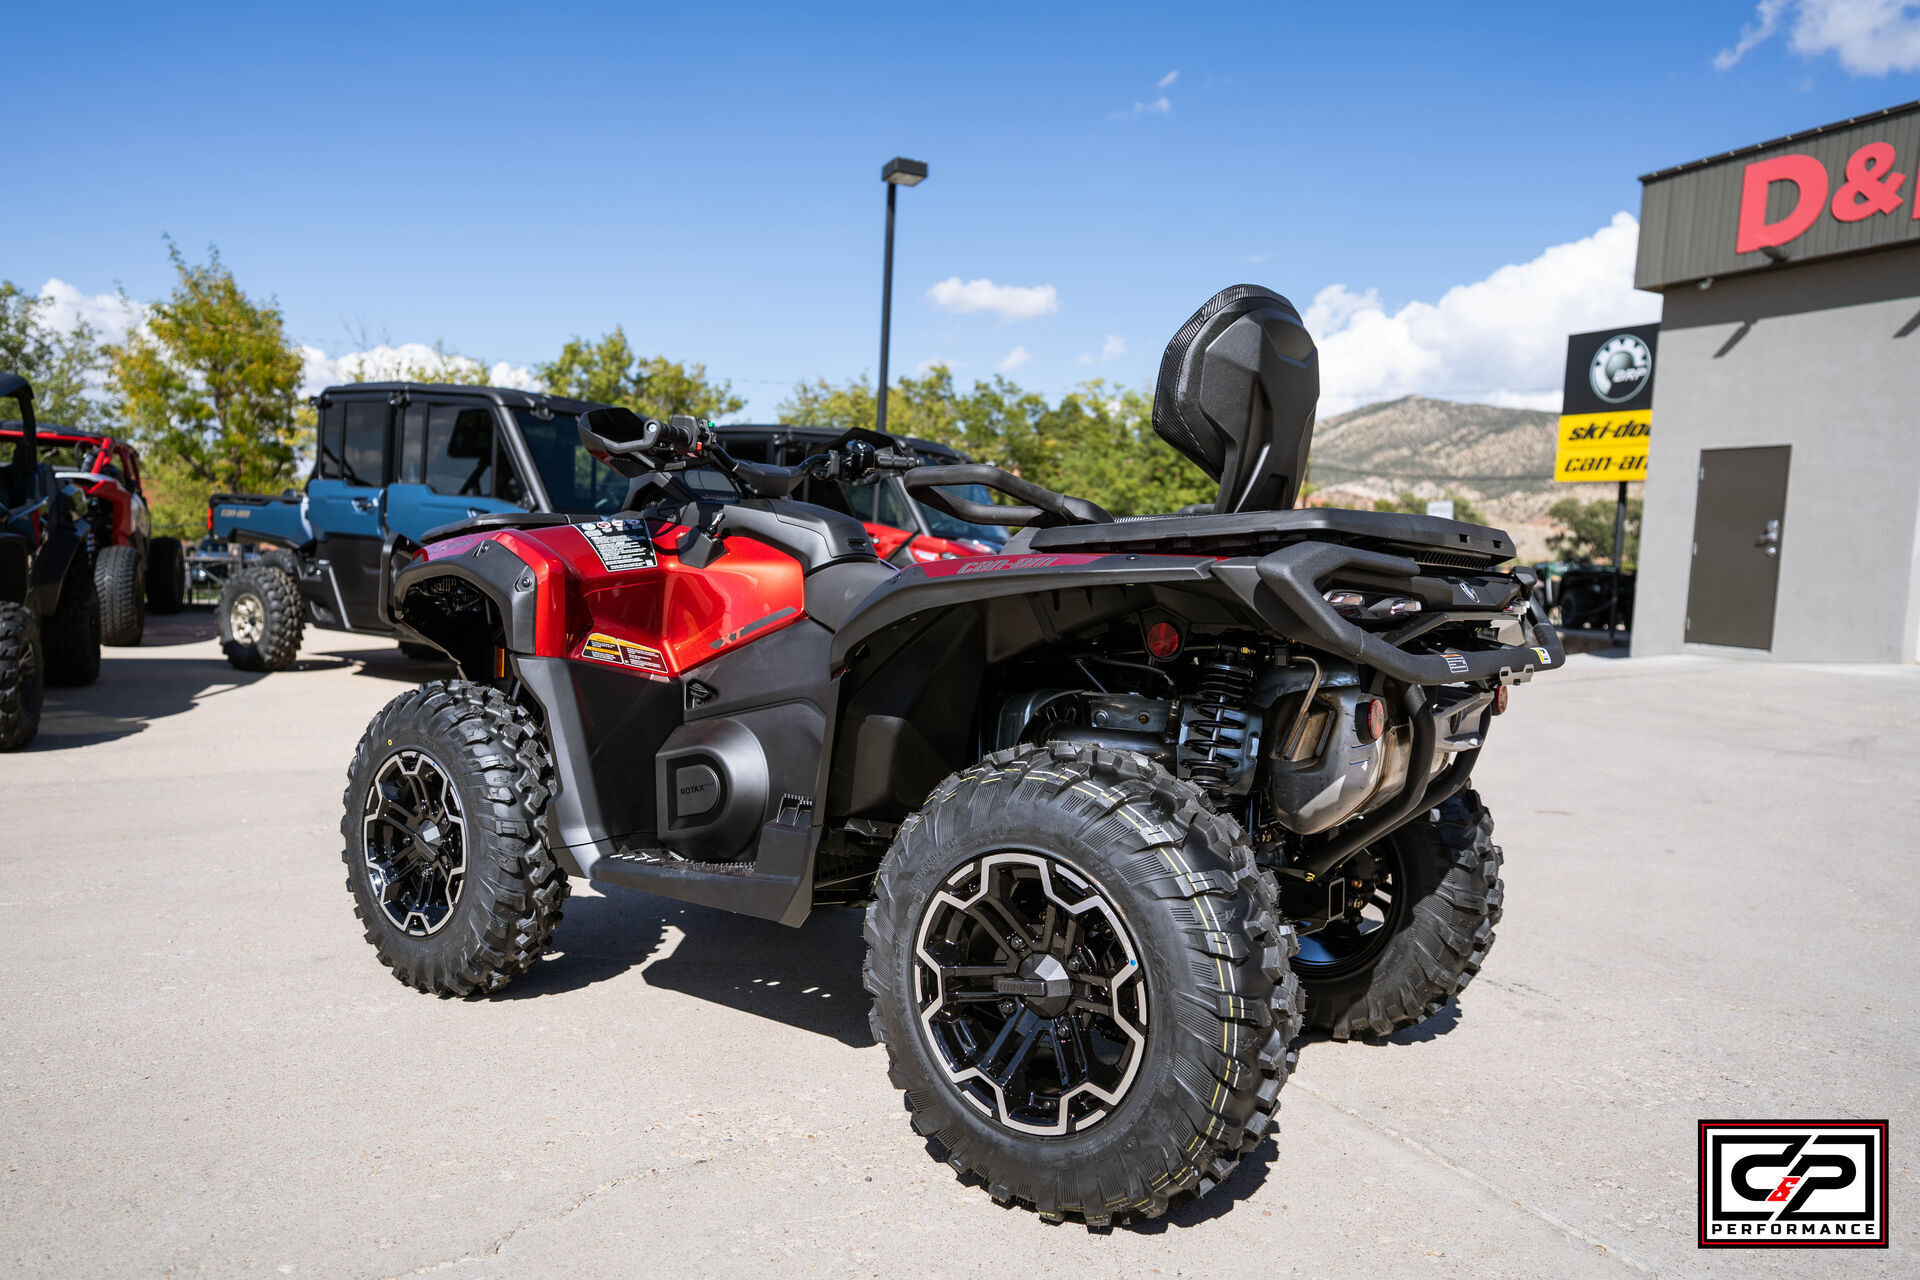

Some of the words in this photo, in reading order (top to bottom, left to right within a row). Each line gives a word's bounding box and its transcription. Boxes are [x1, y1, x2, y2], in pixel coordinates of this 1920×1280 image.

[1736, 141, 1920, 254] D&
[1612, 366, 1648, 384] BRP
[957, 556, 1059, 575] can-am
[719, 626, 745, 648] XT
[680, 784, 705, 796] ROTAX
